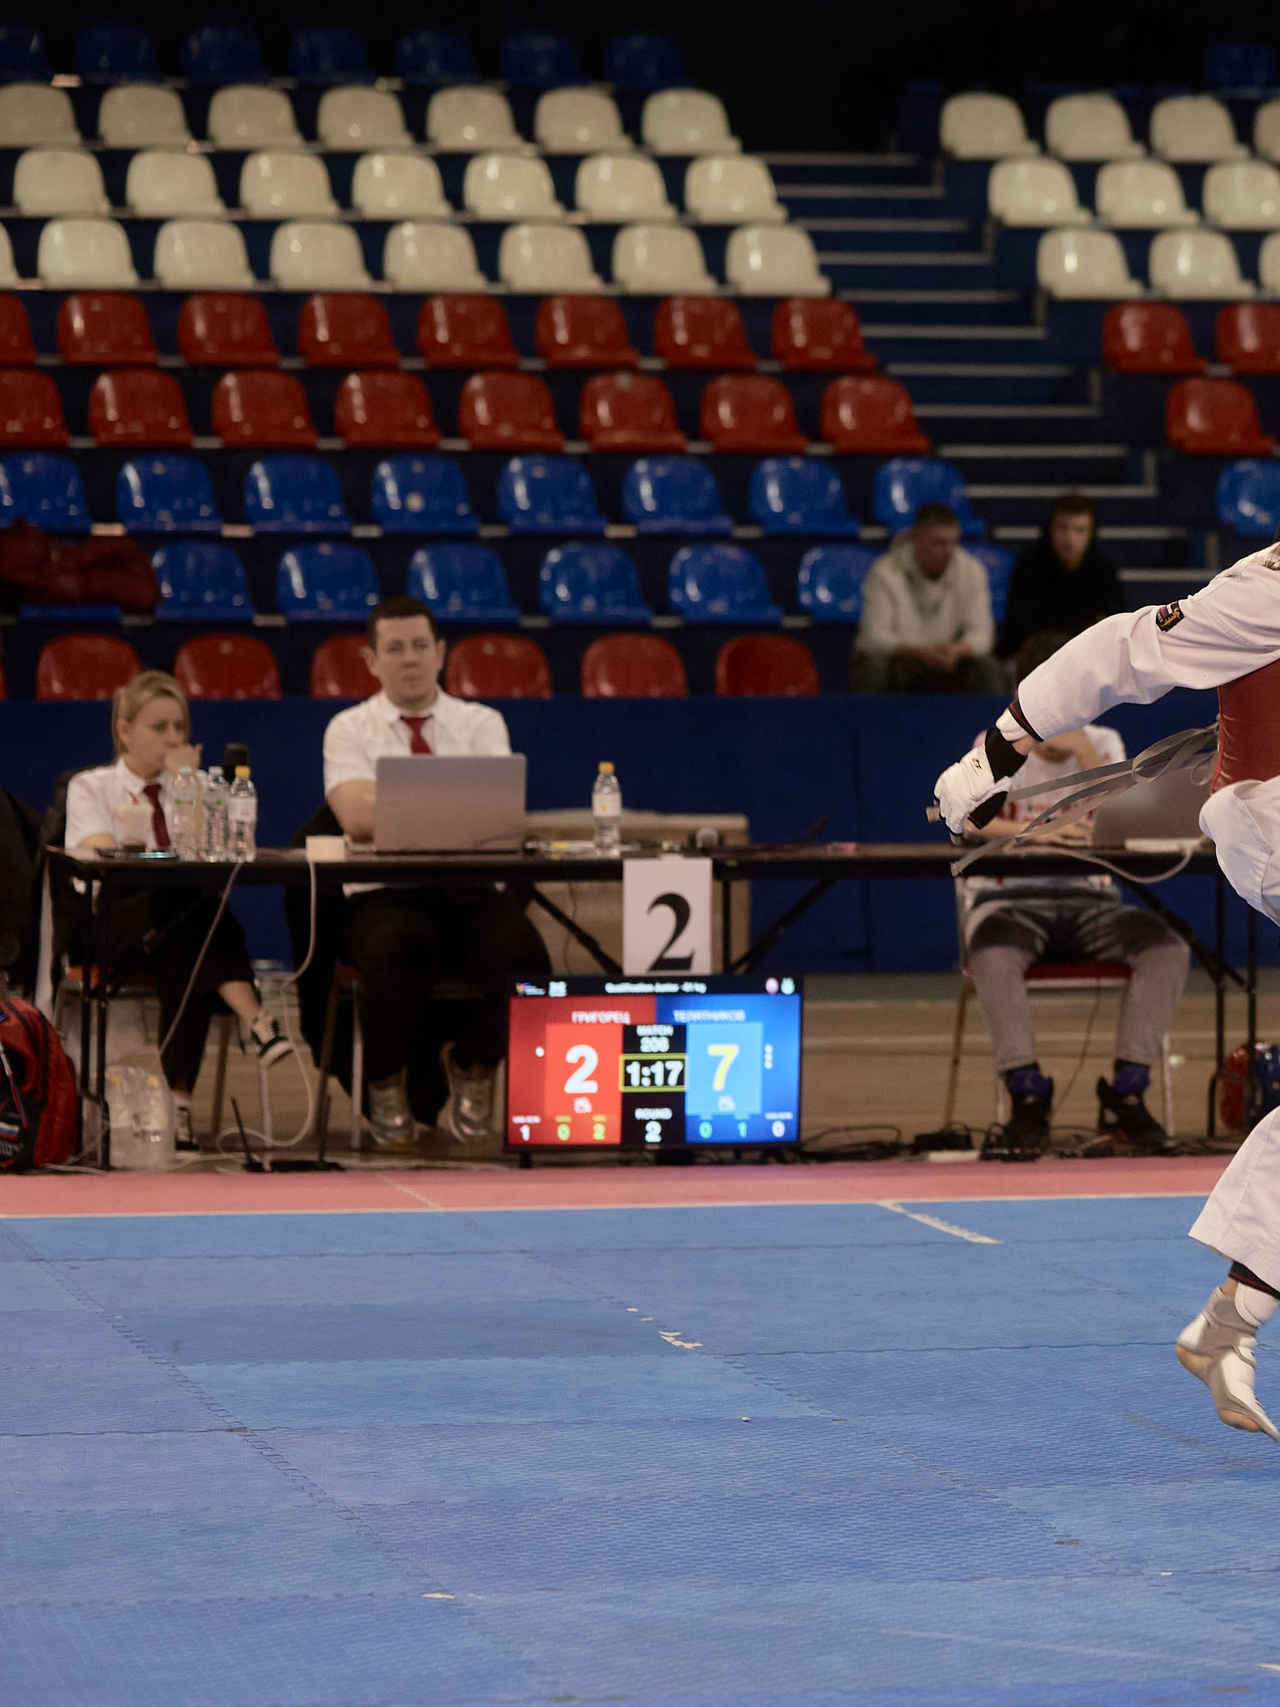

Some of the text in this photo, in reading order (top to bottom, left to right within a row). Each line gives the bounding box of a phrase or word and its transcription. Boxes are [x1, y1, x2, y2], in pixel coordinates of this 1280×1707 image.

[646, 892, 695, 971] 2
[636, 1025, 674, 1037] MATCH
[564, 1044, 599, 1094] 2
[626, 1061, 684, 1088] 1:17
[707, 1043, 740, 1092] 7
[634, 1108, 673, 1121] ROUND
[520, 1124, 530, 1142] 1
[557, 1123, 571, 1141] 0
[592, 1122, 606, 1141] 2
[645, 1121, 662, 1143] 2
[699, 1121, 713, 1139] 0
[737, 1121, 747, 1138] 1
[772, 1120, 786, 1138] 0
